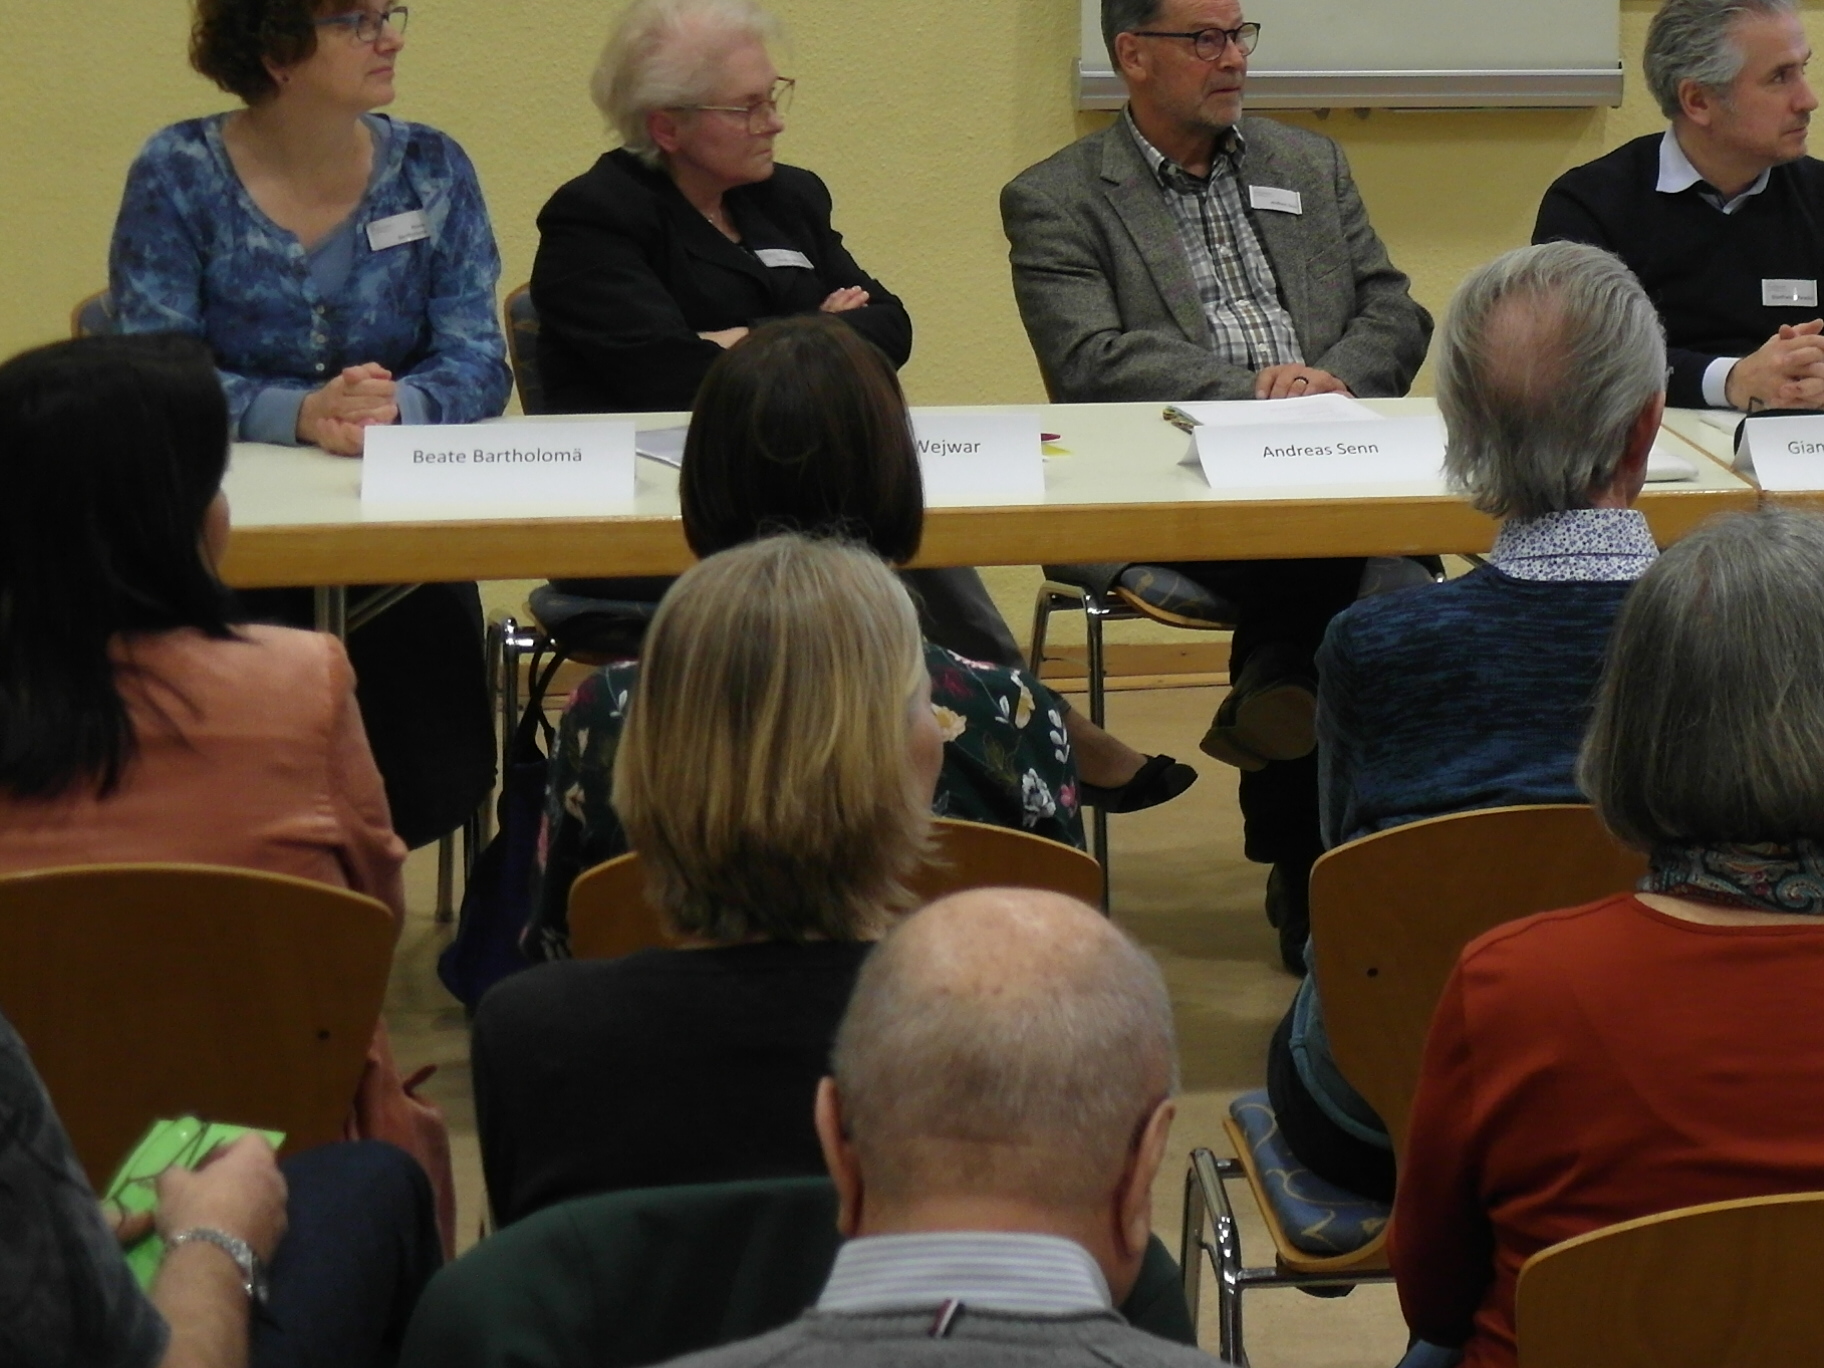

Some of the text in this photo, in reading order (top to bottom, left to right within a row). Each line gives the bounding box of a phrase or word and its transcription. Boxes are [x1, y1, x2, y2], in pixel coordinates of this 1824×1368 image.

[412, 447, 582, 464] Beate Bartholomä
[1263, 442, 1379, 458] Andreas Senn
